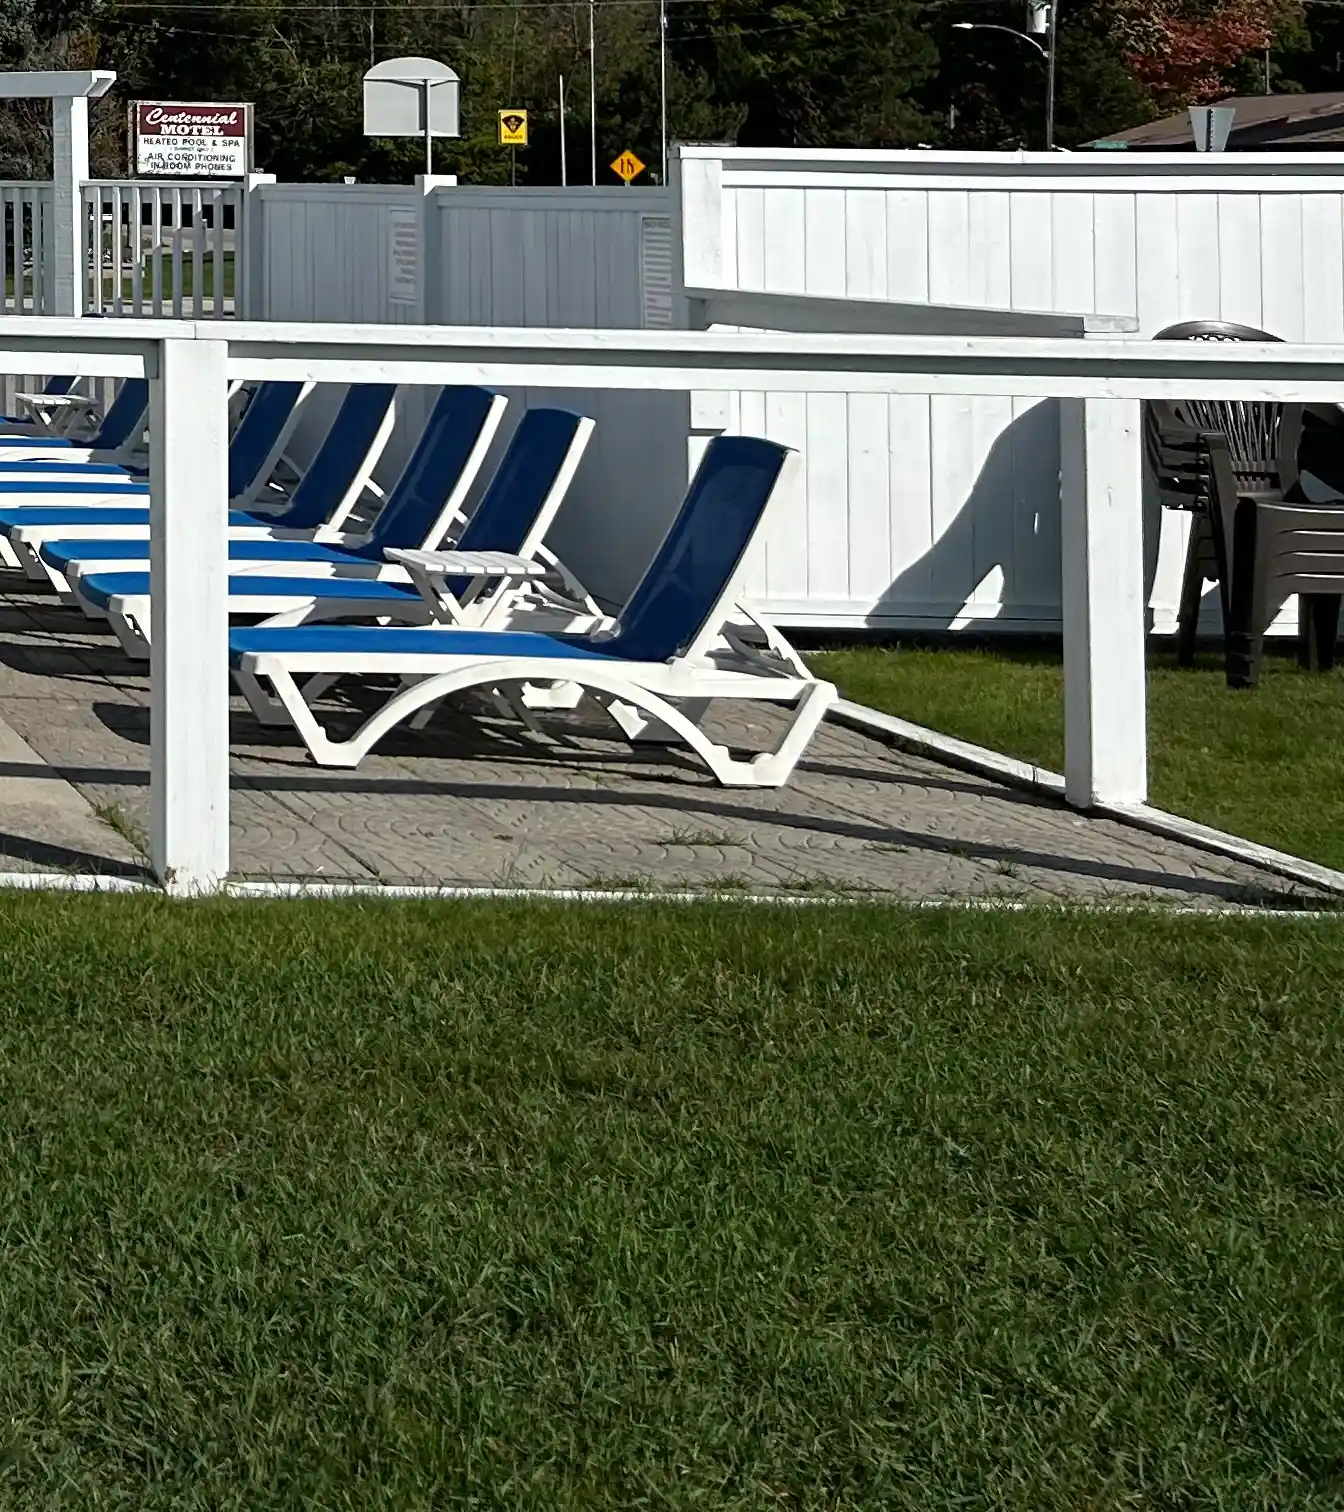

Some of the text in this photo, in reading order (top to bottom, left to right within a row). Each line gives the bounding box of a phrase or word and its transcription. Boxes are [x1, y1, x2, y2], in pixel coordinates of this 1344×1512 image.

[145, 108, 237, 125] Centennial
[160, 124, 224, 136] MOTEL
[144, 138, 178, 146] HEATED
[182, 138, 207, 146] POOL
[148, 152, 236, 162] AIR CONDITIONING
[195, 162, 232, 170] PHONES
